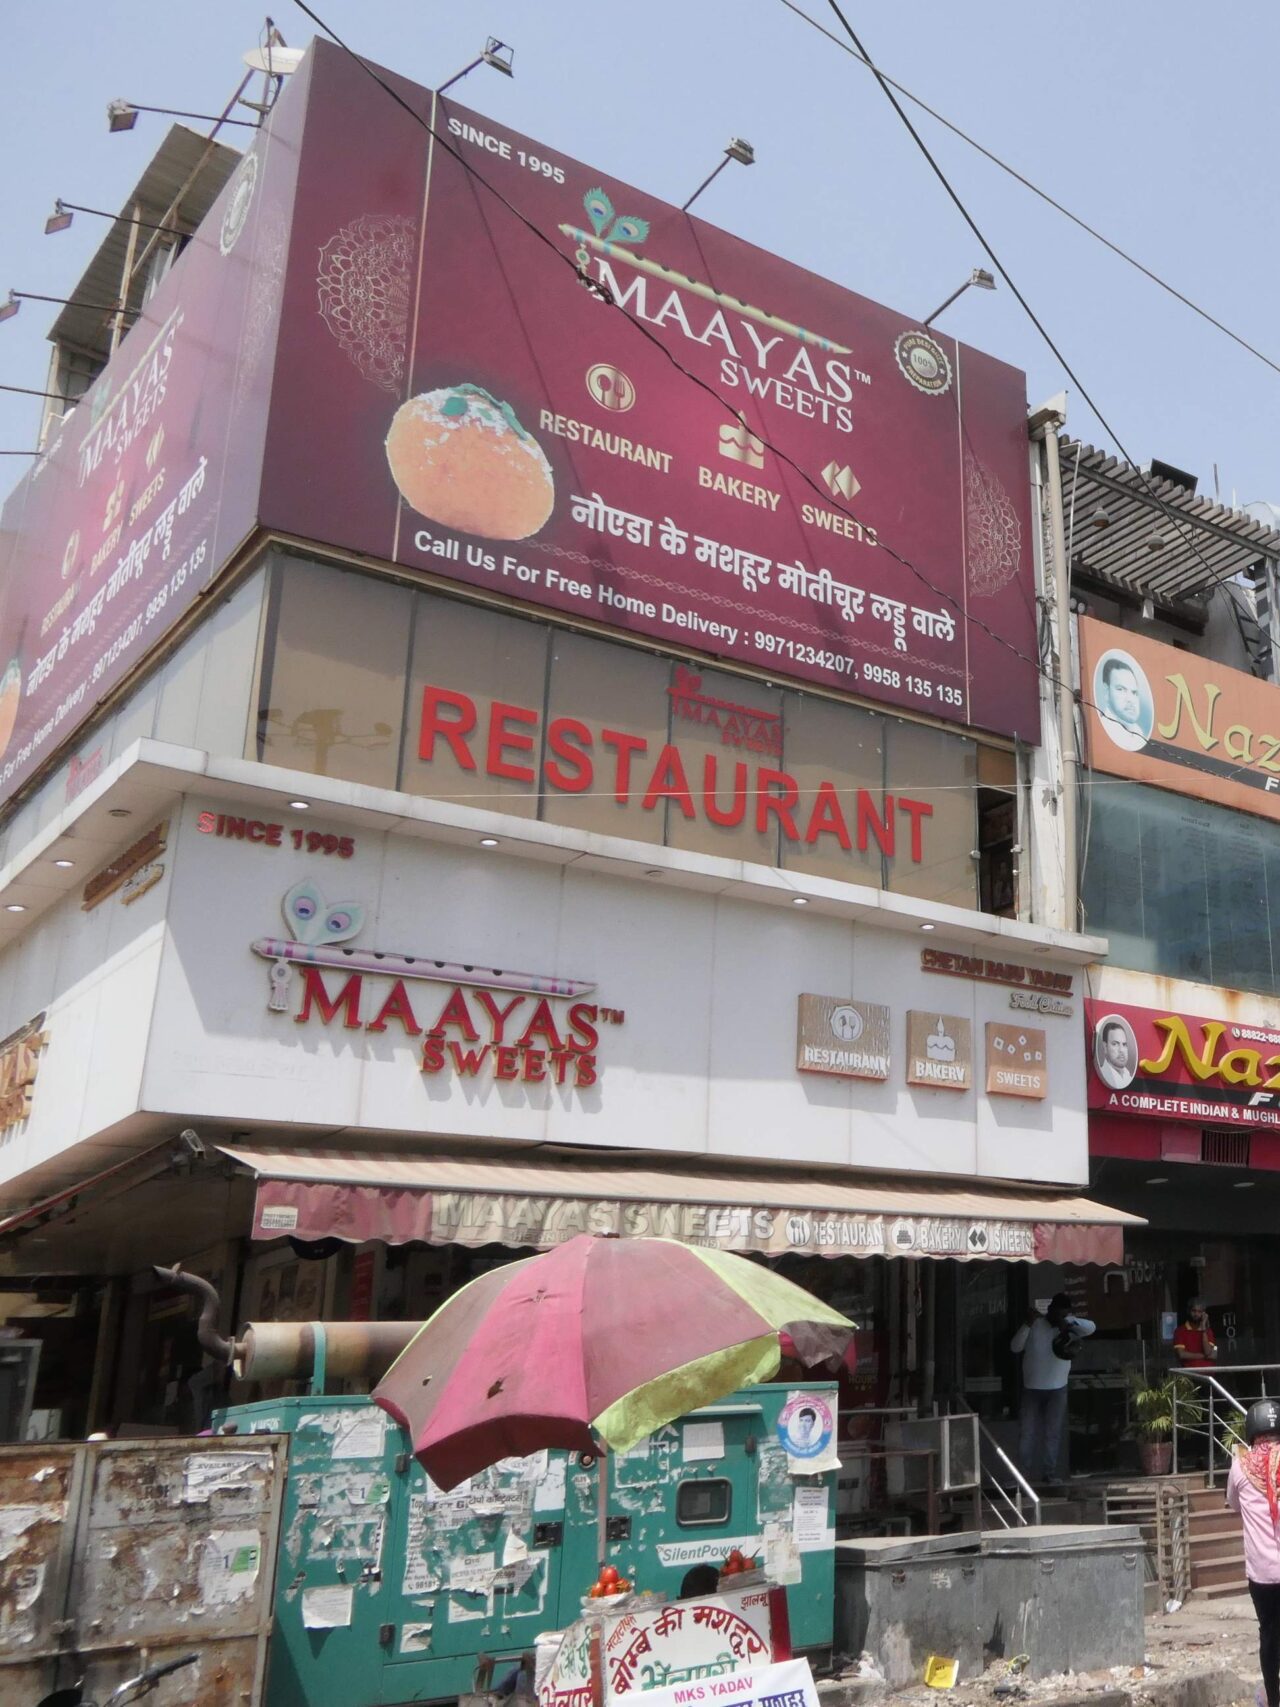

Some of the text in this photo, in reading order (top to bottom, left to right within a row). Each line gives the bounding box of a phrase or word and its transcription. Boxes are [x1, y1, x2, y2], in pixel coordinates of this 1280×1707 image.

[448, 117, 565, 185] SINCE 1995
[592, 256, 854, 403] MAAYAS
[720, 359, 854, 433] SWEETS
[539, 409, 673, 474] RESTAURANT
[699, 467, 781, 512] BAKERY
[801, 504, 878, 547] SWEETS
[570, 492, 955, 651] नोएडा के मशहूर मोतीचूर लड्डू वाले
[414, 530, 962, 706] Call Us For Free Home Delivery 9971234207, 9958 135 135
[418, 685, 934, 864] RESTAURANT
[196, 811, 355, 859] SINCE 1995
[293, 966, 599, 1054] MAAYAS
[420, 1033, 598, 1089] SWEETS
[915, 1060, 965, 1082] BAKERY
[996, 1071, 1041, 1088] SWEETS
[1109, 1093, 1118, 1105] A
[1121, 1095, 1189, 1113] COMPLETE
[1190, 1103, 1228, 1119] INDIAN
[1231, 1107, 1240, 1119] &
[623, 1201, 775, 1241] SWEETS
[919, 1224, 1033, 1253] BAKERY SWEETS
[652, 1605, 686, 1638] की
[673, 1686, 706, 1703] MKS
[709, 1676, 754, 1696] YADAV
